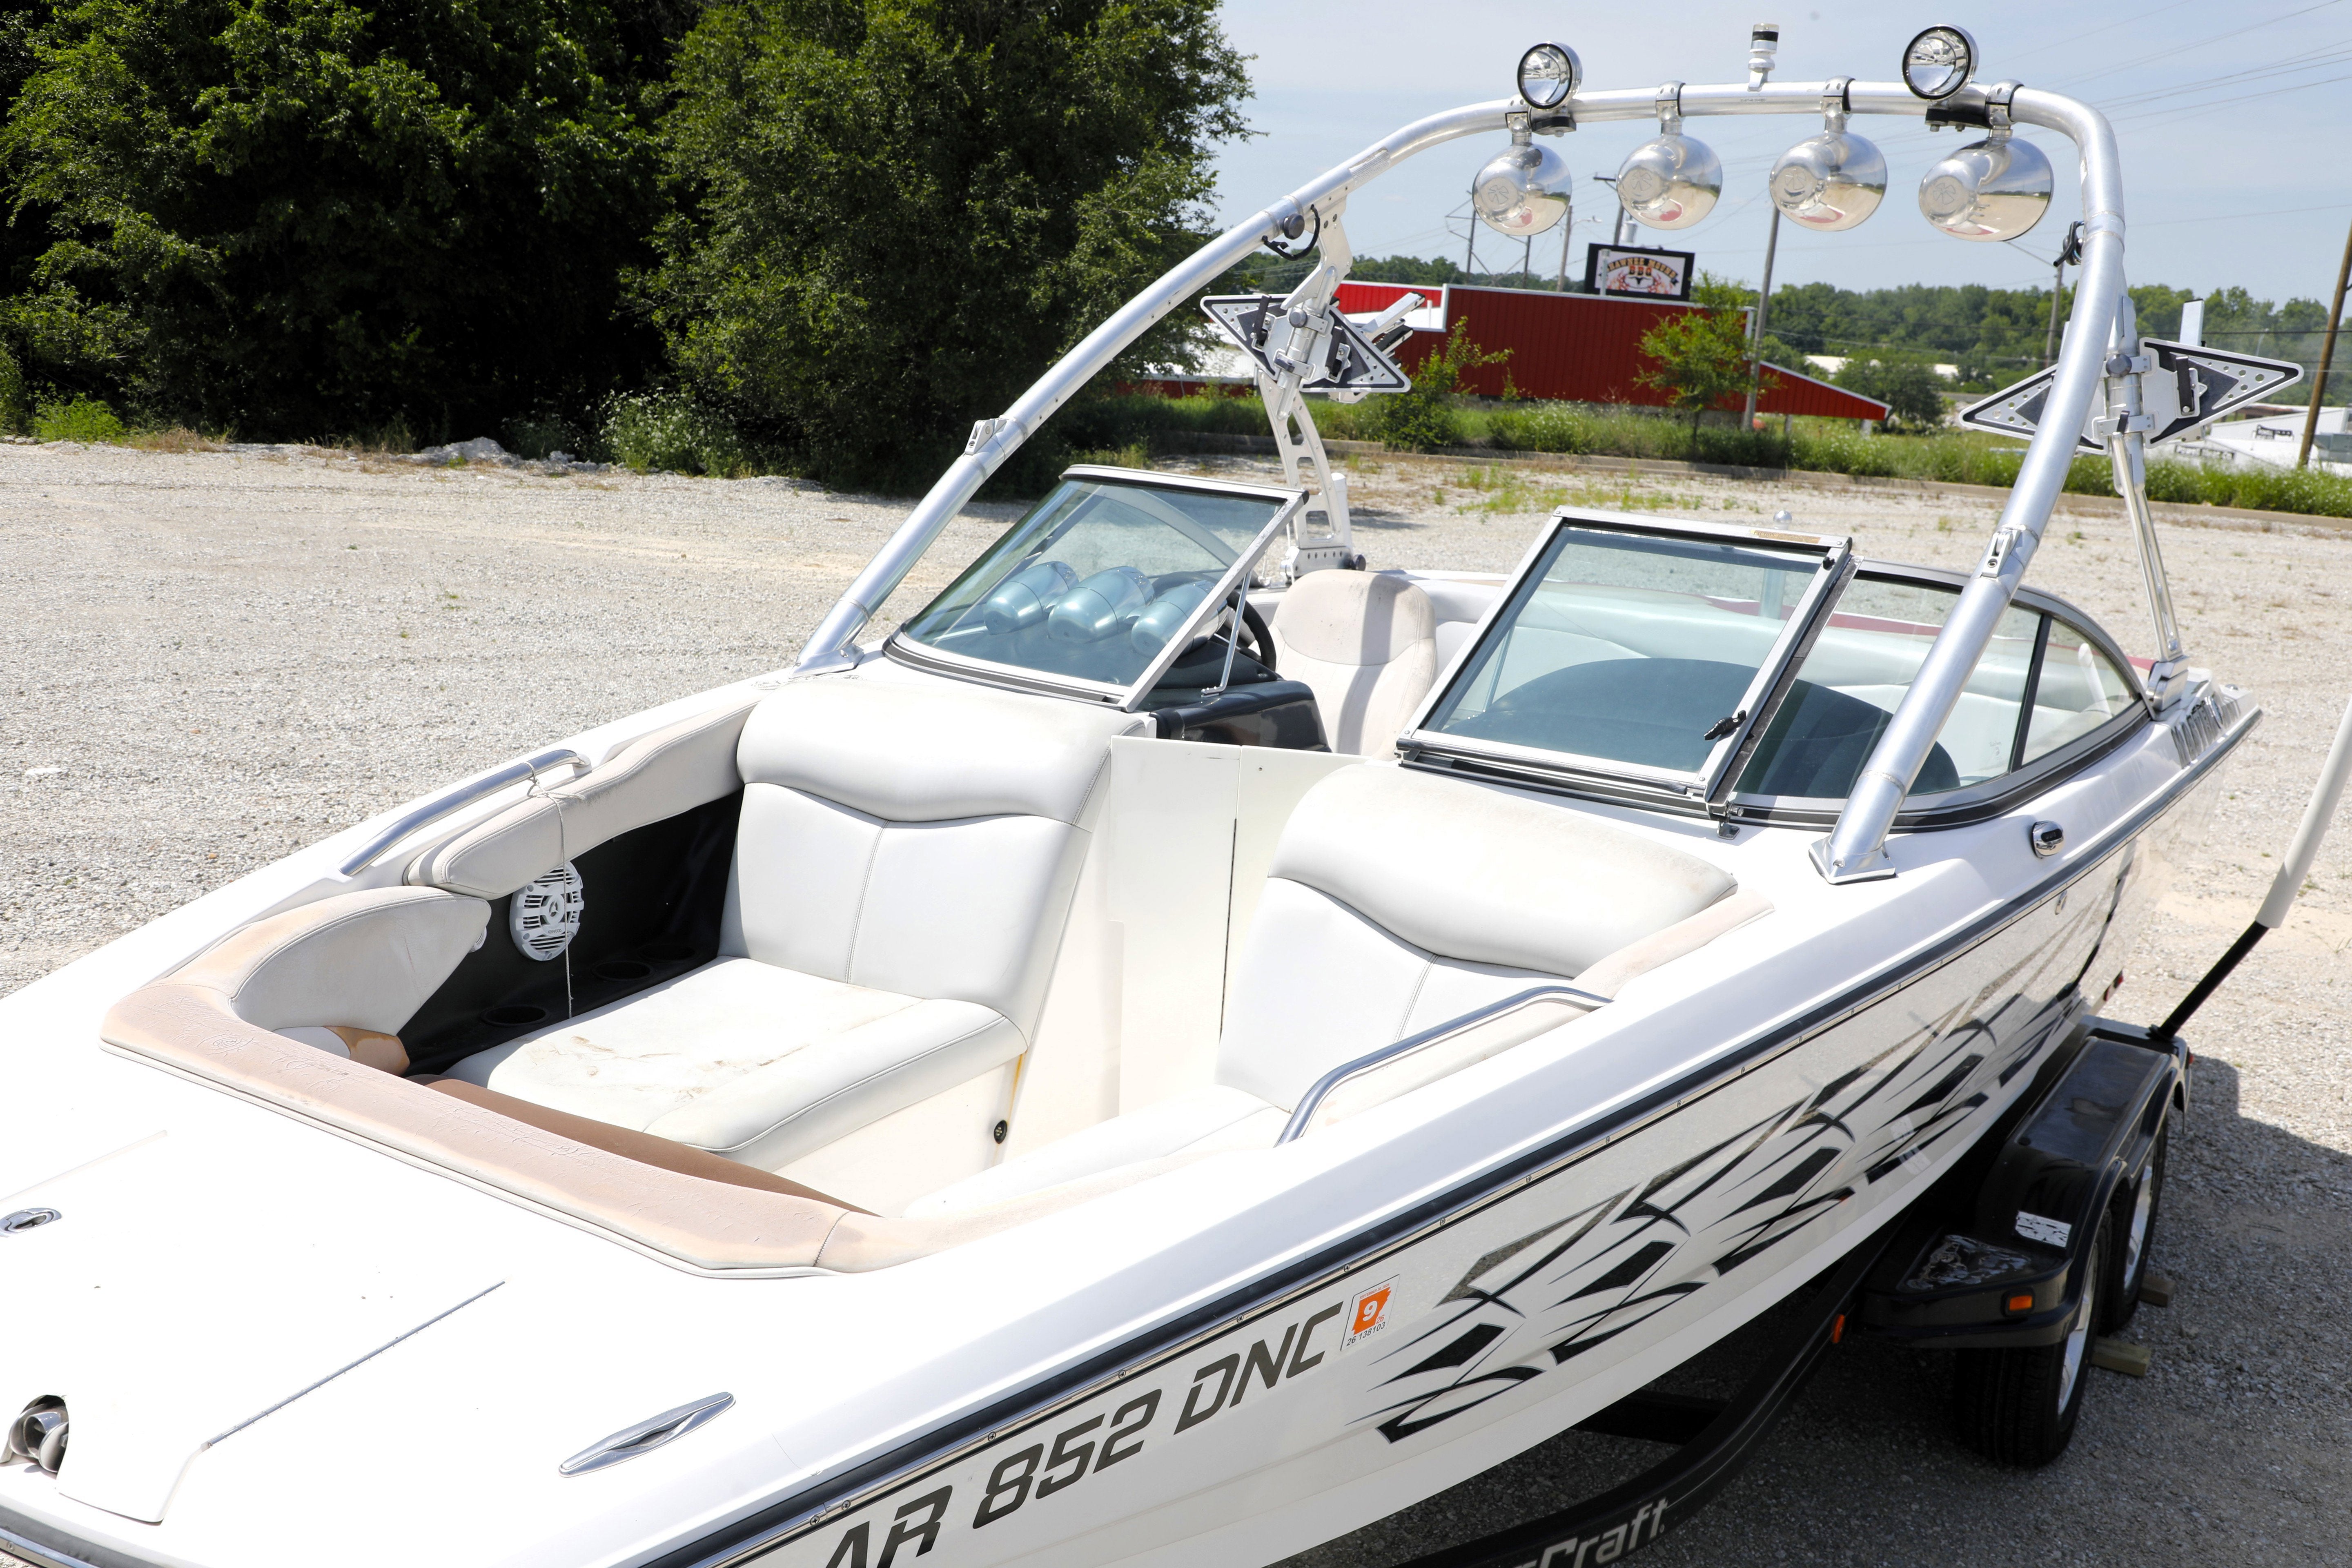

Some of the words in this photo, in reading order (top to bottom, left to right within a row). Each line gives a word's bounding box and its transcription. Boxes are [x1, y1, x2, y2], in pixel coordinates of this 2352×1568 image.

[1629, 265, 1652, 276] BBQ
[1362, 1301, 1378, 1321] 9
[1376, 1314, 1385, 1324] 26
[1346, 1336, 1356, 1347] 26
[1359, 1321, 1385, 1340] 138103
[825, 1485, 953, 1568] AR
[973, 1389, 1162, 1529] 852
[1174, 1301, 1343, 1435] DNC
[1513, 1497, 1669, 1568] Craft
